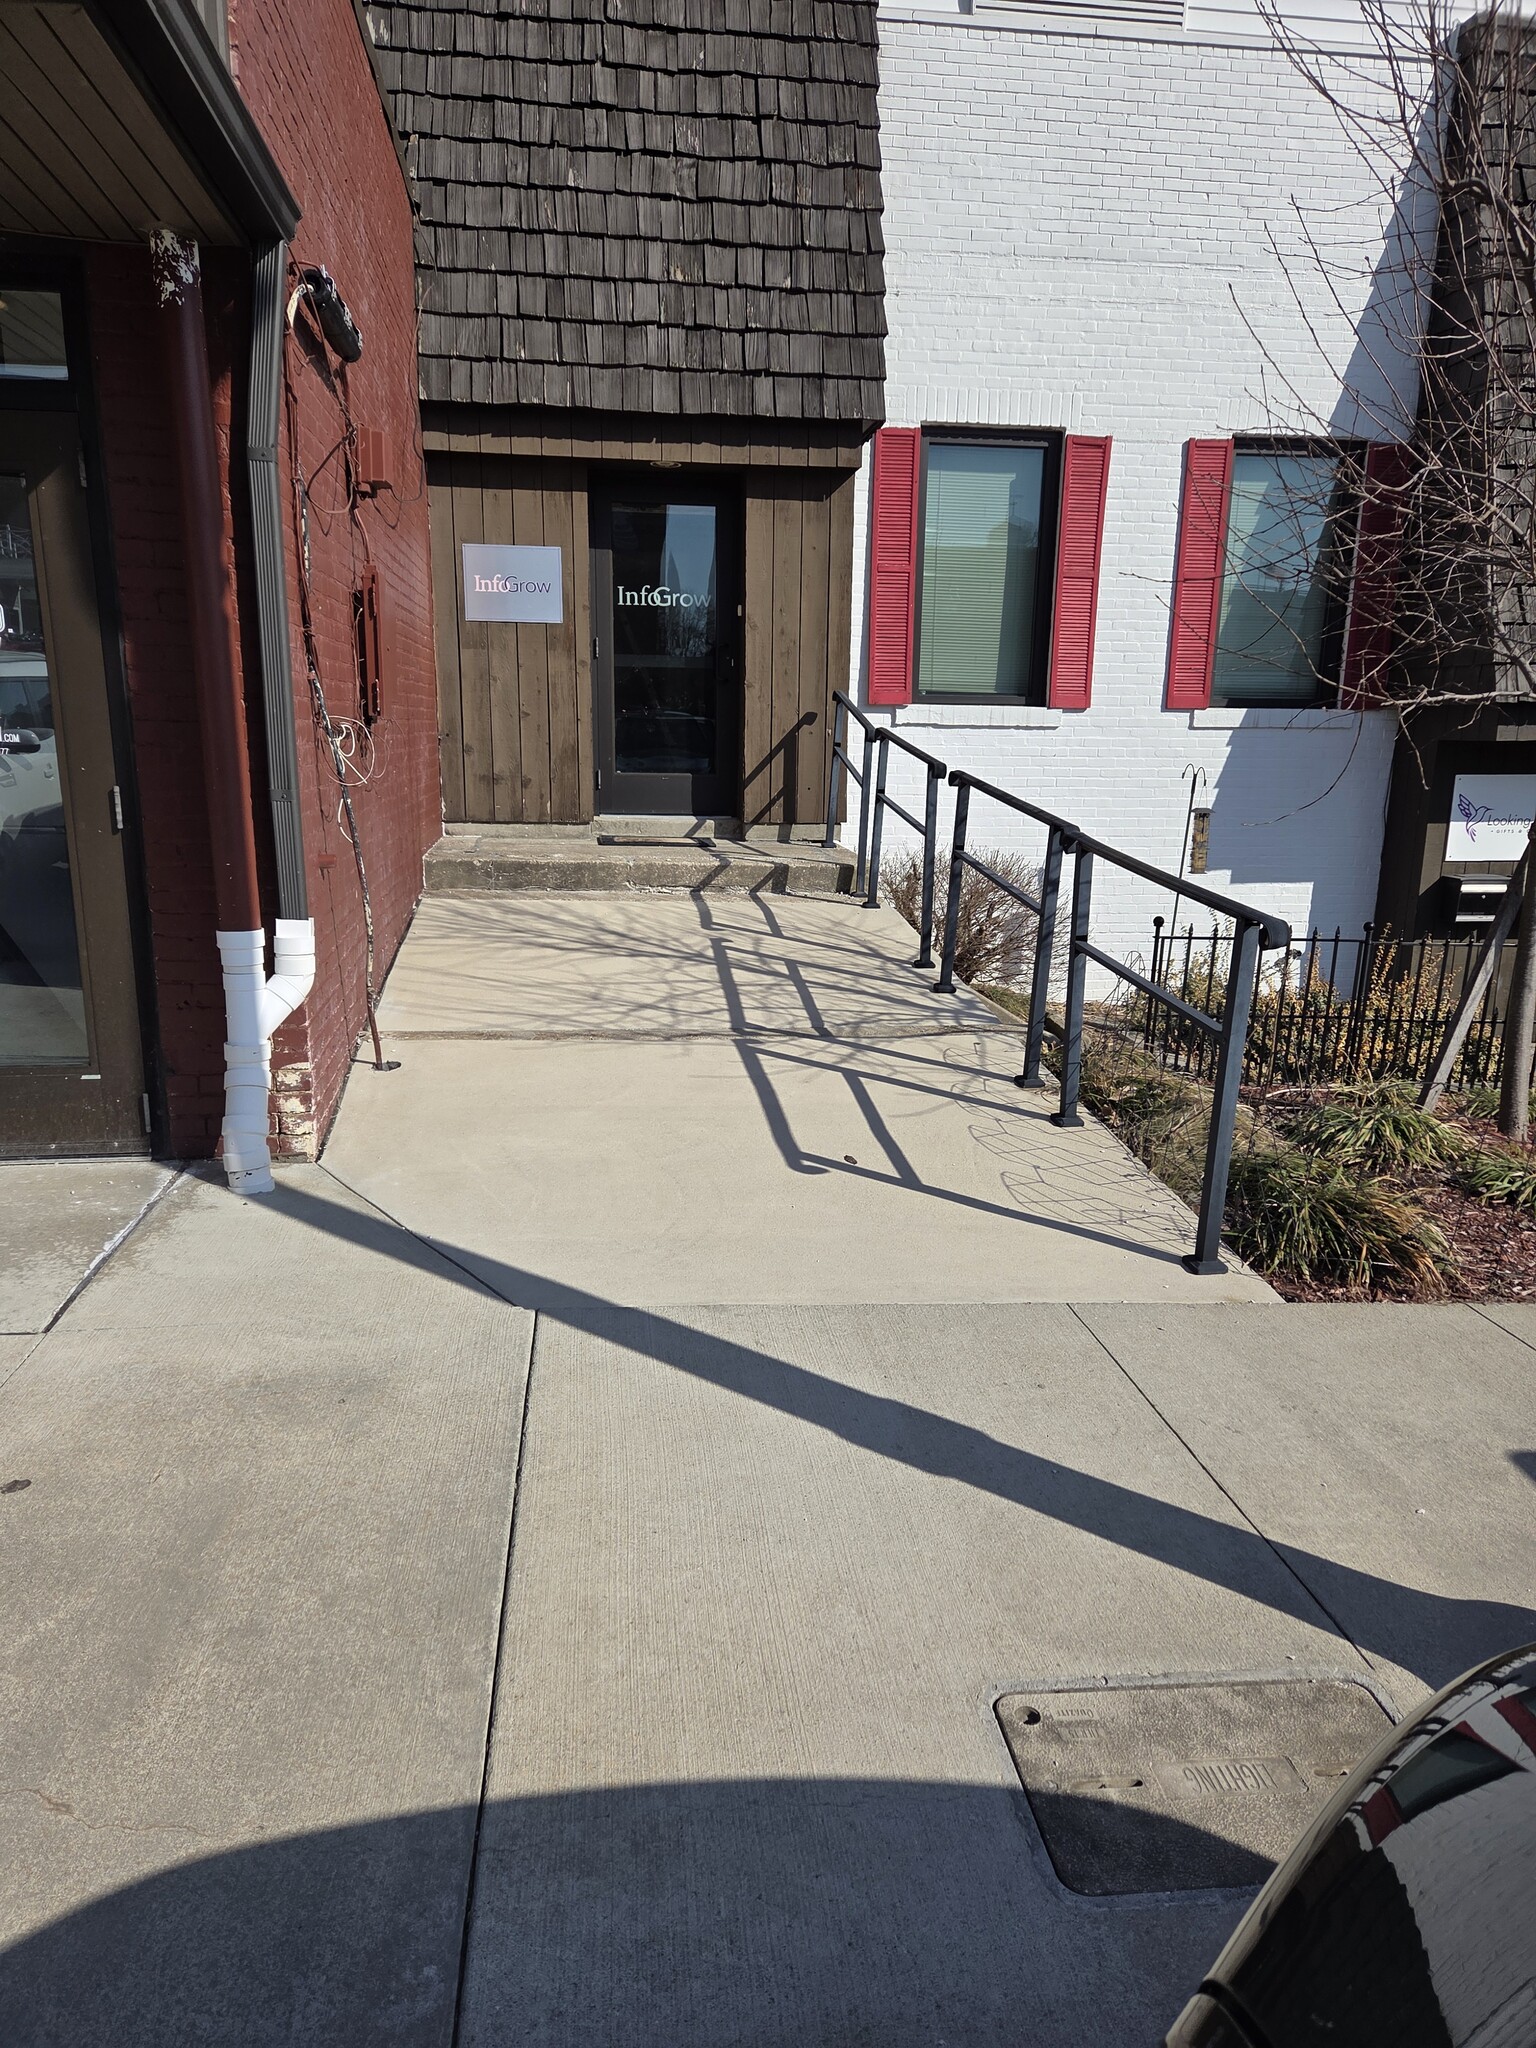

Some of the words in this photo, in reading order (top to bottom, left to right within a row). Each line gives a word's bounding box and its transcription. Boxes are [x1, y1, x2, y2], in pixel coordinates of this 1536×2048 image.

[474, 574, 551, 594] InfoGrow
[617, 585, 712, 608] InfoGrow
[0, 726, 20, 743] .COM
[1487, 814, 1531, 829] Looking
[1182, 1763, 1279, 1794] LIGHTING
